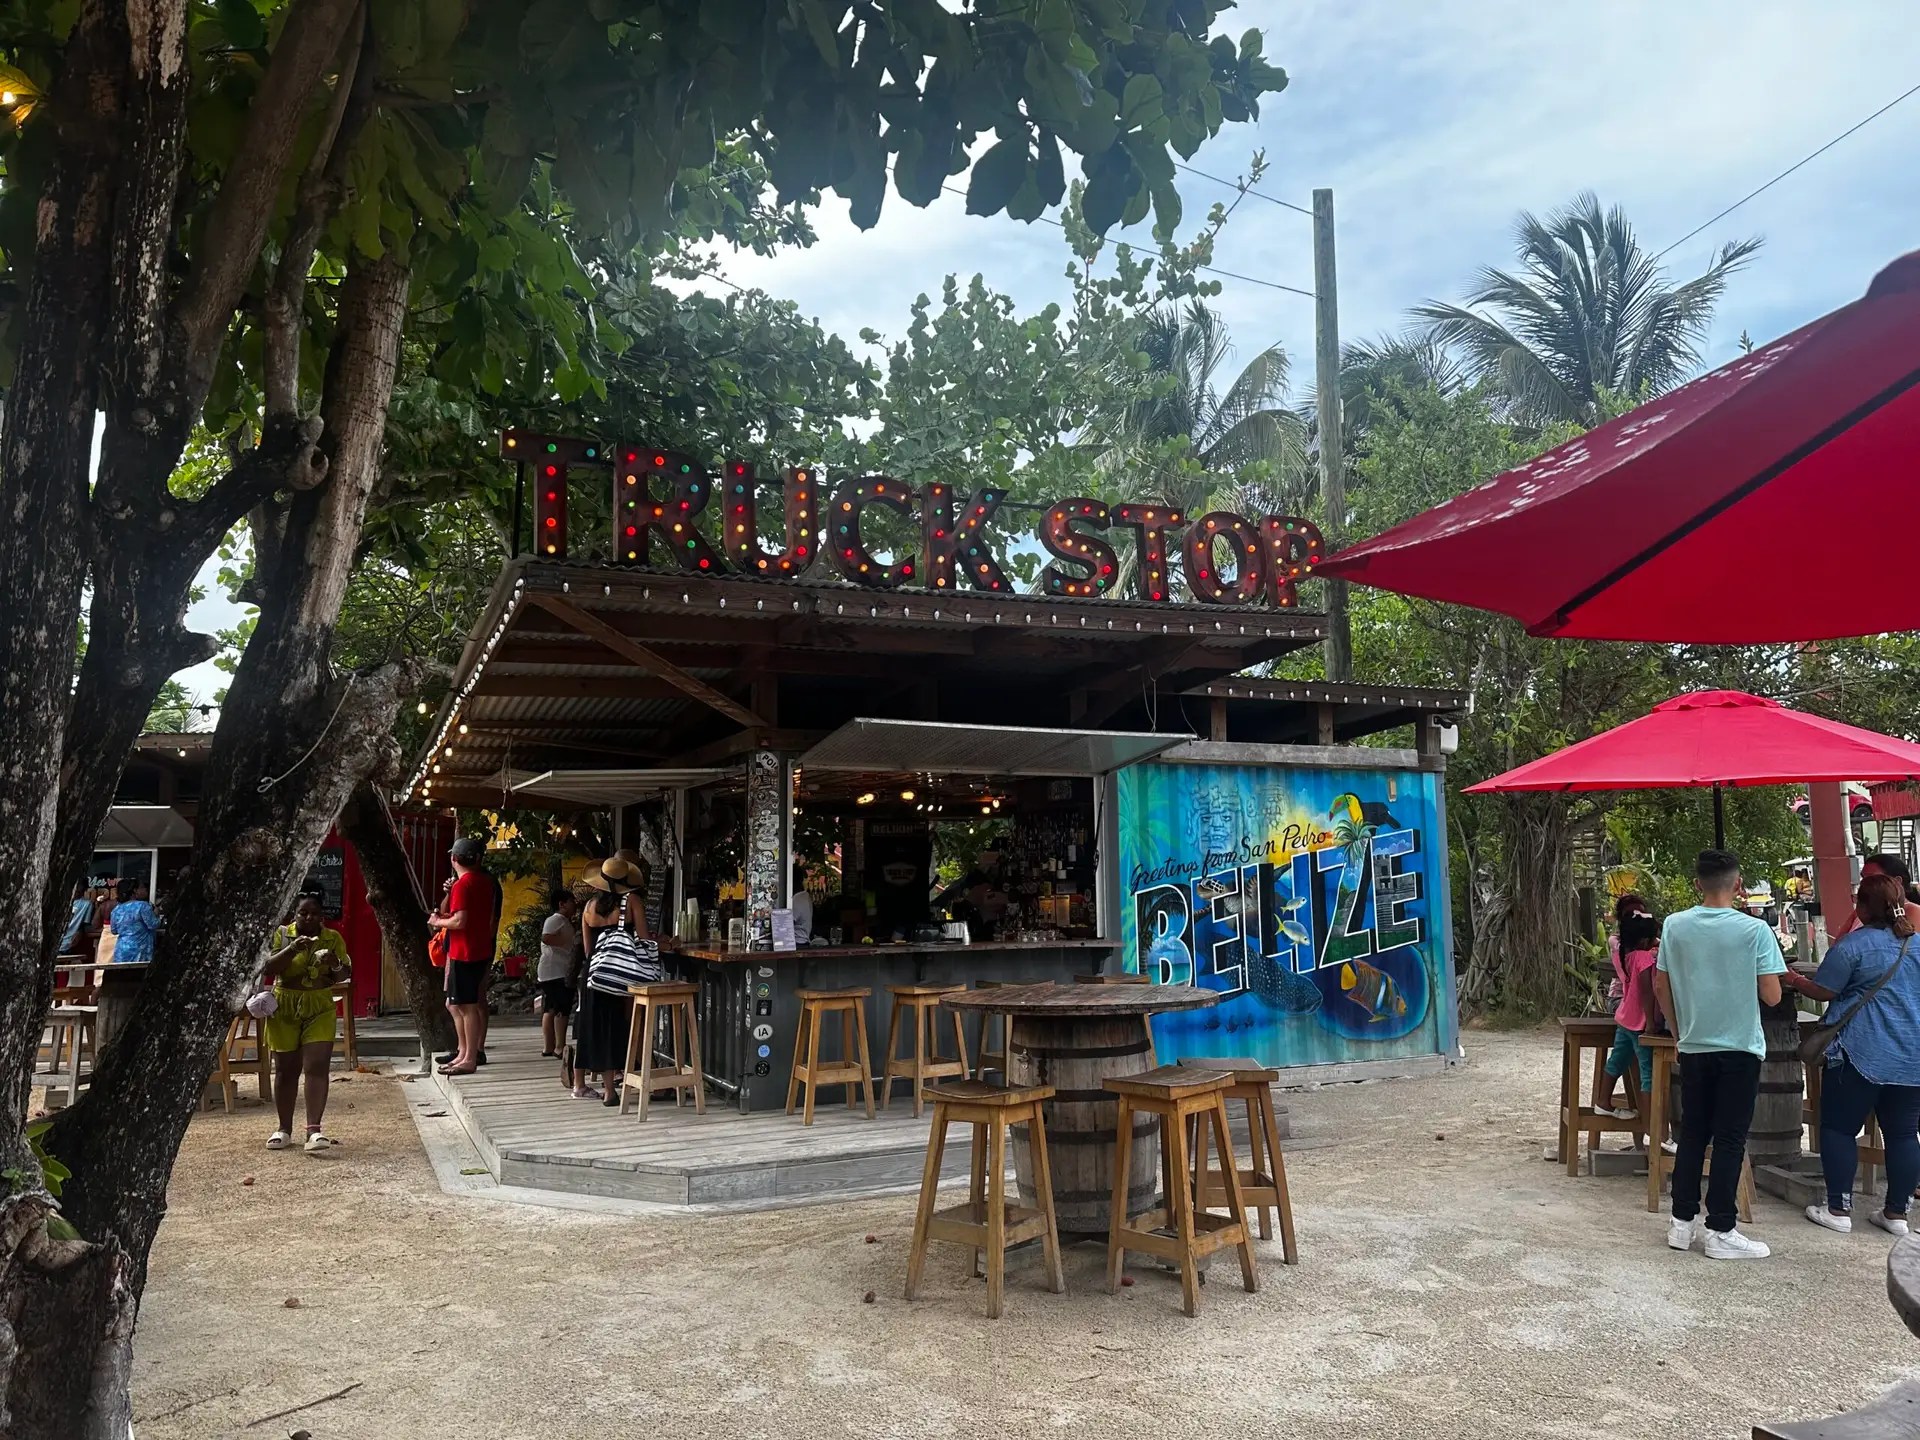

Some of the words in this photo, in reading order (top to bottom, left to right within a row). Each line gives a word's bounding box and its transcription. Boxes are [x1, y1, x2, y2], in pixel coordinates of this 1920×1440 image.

[500, 430, 1015, 592] TRUCK
[1041, 498, 1324, 606] STOP
[1130, 859, 1198, 897] Greetings
[1201, 849, 1238, 878] from
[1240, 835, 1277, 863] San
[1281, 823, 1327, 853] Pedro
[1134, 828, 1424, 997] BELIZE
[758, 1027, 769, 1037] IA
